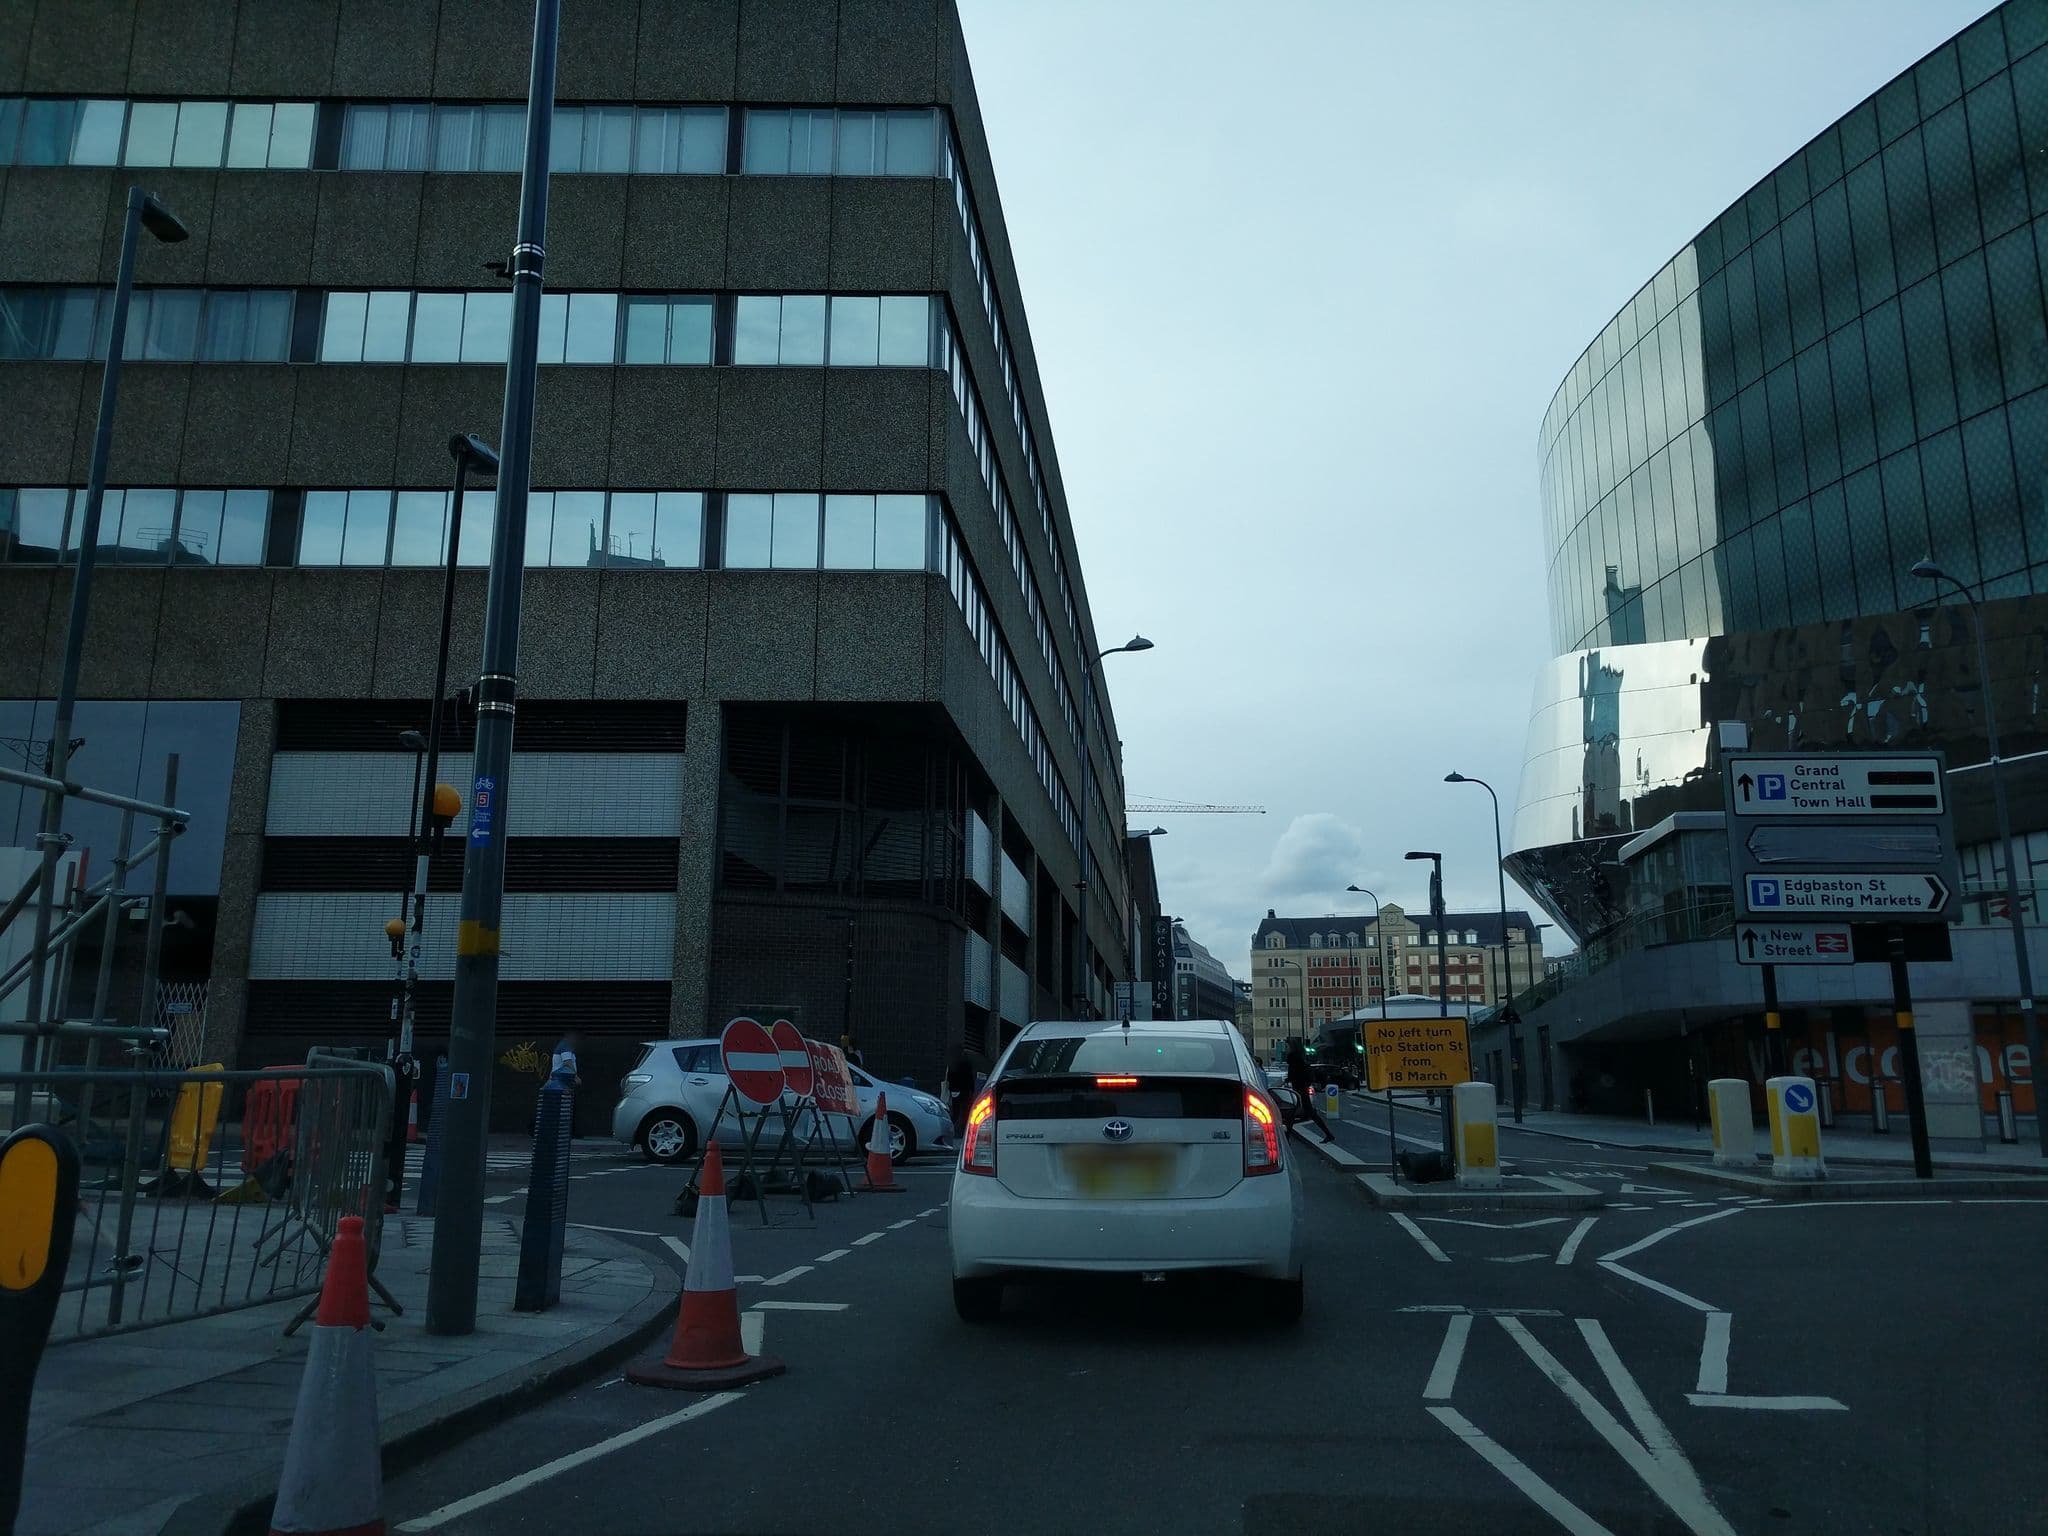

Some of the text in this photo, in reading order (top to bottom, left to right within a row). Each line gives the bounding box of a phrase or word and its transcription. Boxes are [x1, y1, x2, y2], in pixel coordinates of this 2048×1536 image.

[1794, 765, 1839, 776] Grand
[1764, 777, 1781, 798] P
[1790, 779, 1845, 790] Central
[479, 794, 487, 805] 5
[1791, 796, 1866, 808] Town Hall
[1784, 880, 1886, 892] Edgbaston St
[1758, 882, 1776, 904] P
[1785, 894, 1921, 907] Bull Ring Markets
[1770, 929, 1803, 941] New
[1764, 944, 1812, 956] Street
[1157, 936, 1168, 1001] CASNO
[1378, 1027, 1452, 1038] No left turn
[1370, 1041, 1463, 1055] into Station St
[813, 1055, 839, 1073] ROAD
[1402, 1057, 1431, 1066] from
[1389, 1071, 1448, 1082] 18 March
[816, 1083, 851, 1103] CLOSE
